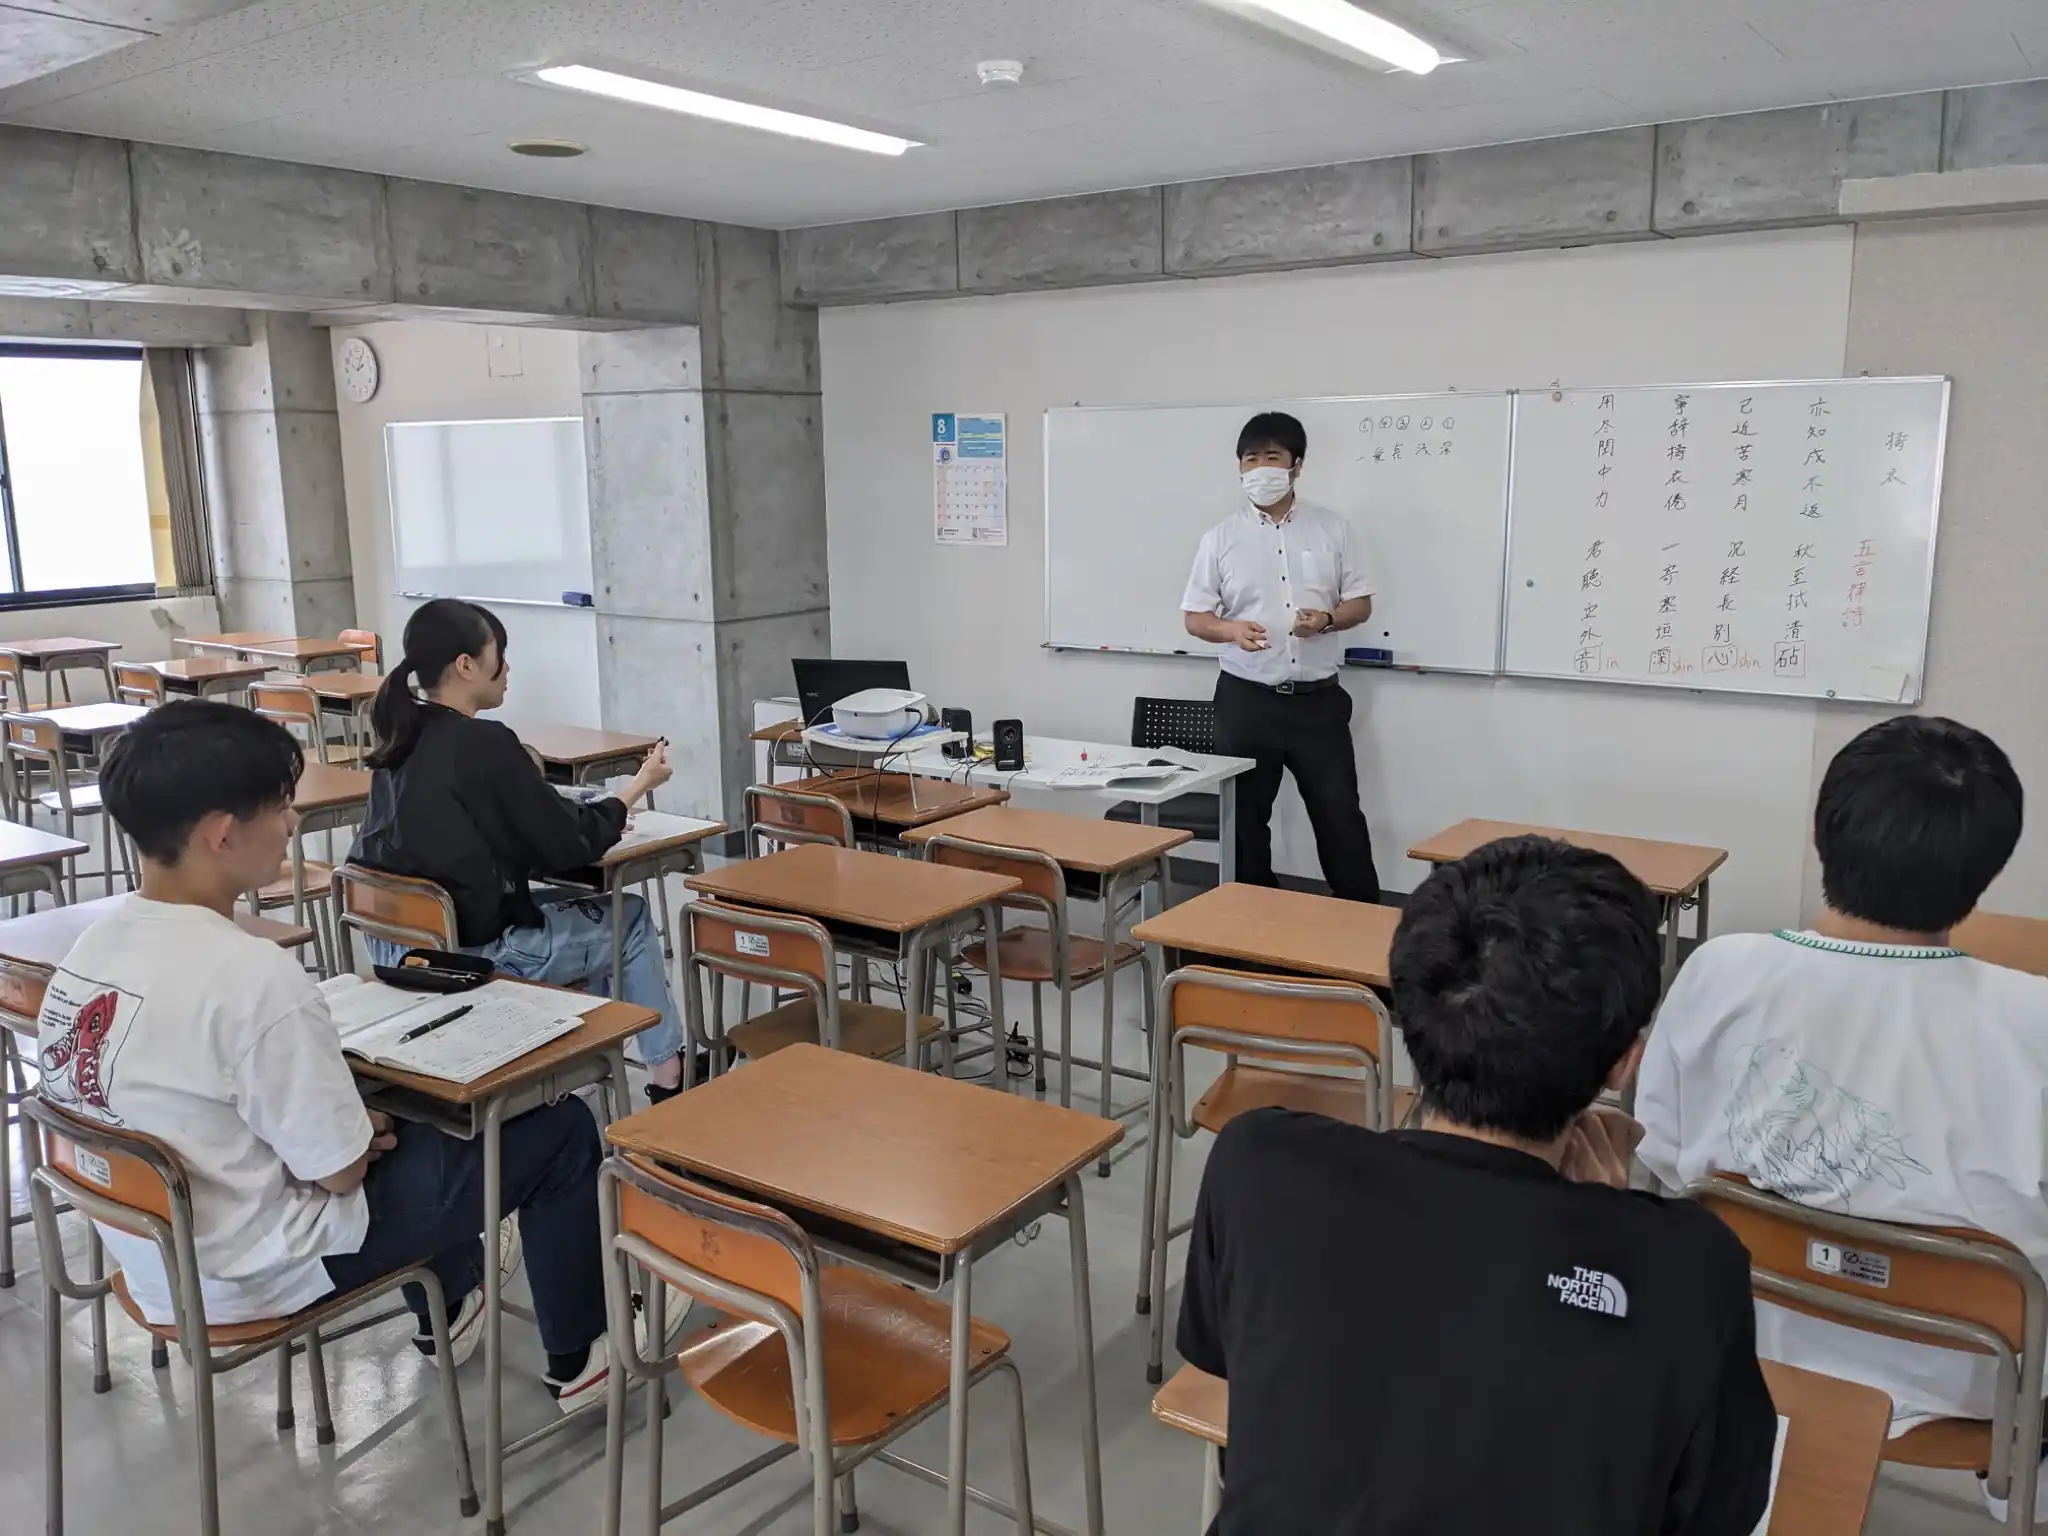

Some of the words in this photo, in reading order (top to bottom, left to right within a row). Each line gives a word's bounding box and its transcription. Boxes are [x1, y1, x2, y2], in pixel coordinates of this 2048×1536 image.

[937, 418, 946, 434] 8
[1822, 1248, 1829, 1261] 1
[1573, 1266, 1602, 1284] THE
[1547, 1273, 1600, 1297] NORTH
[1560, 1289, 1598, 1311] FACE
